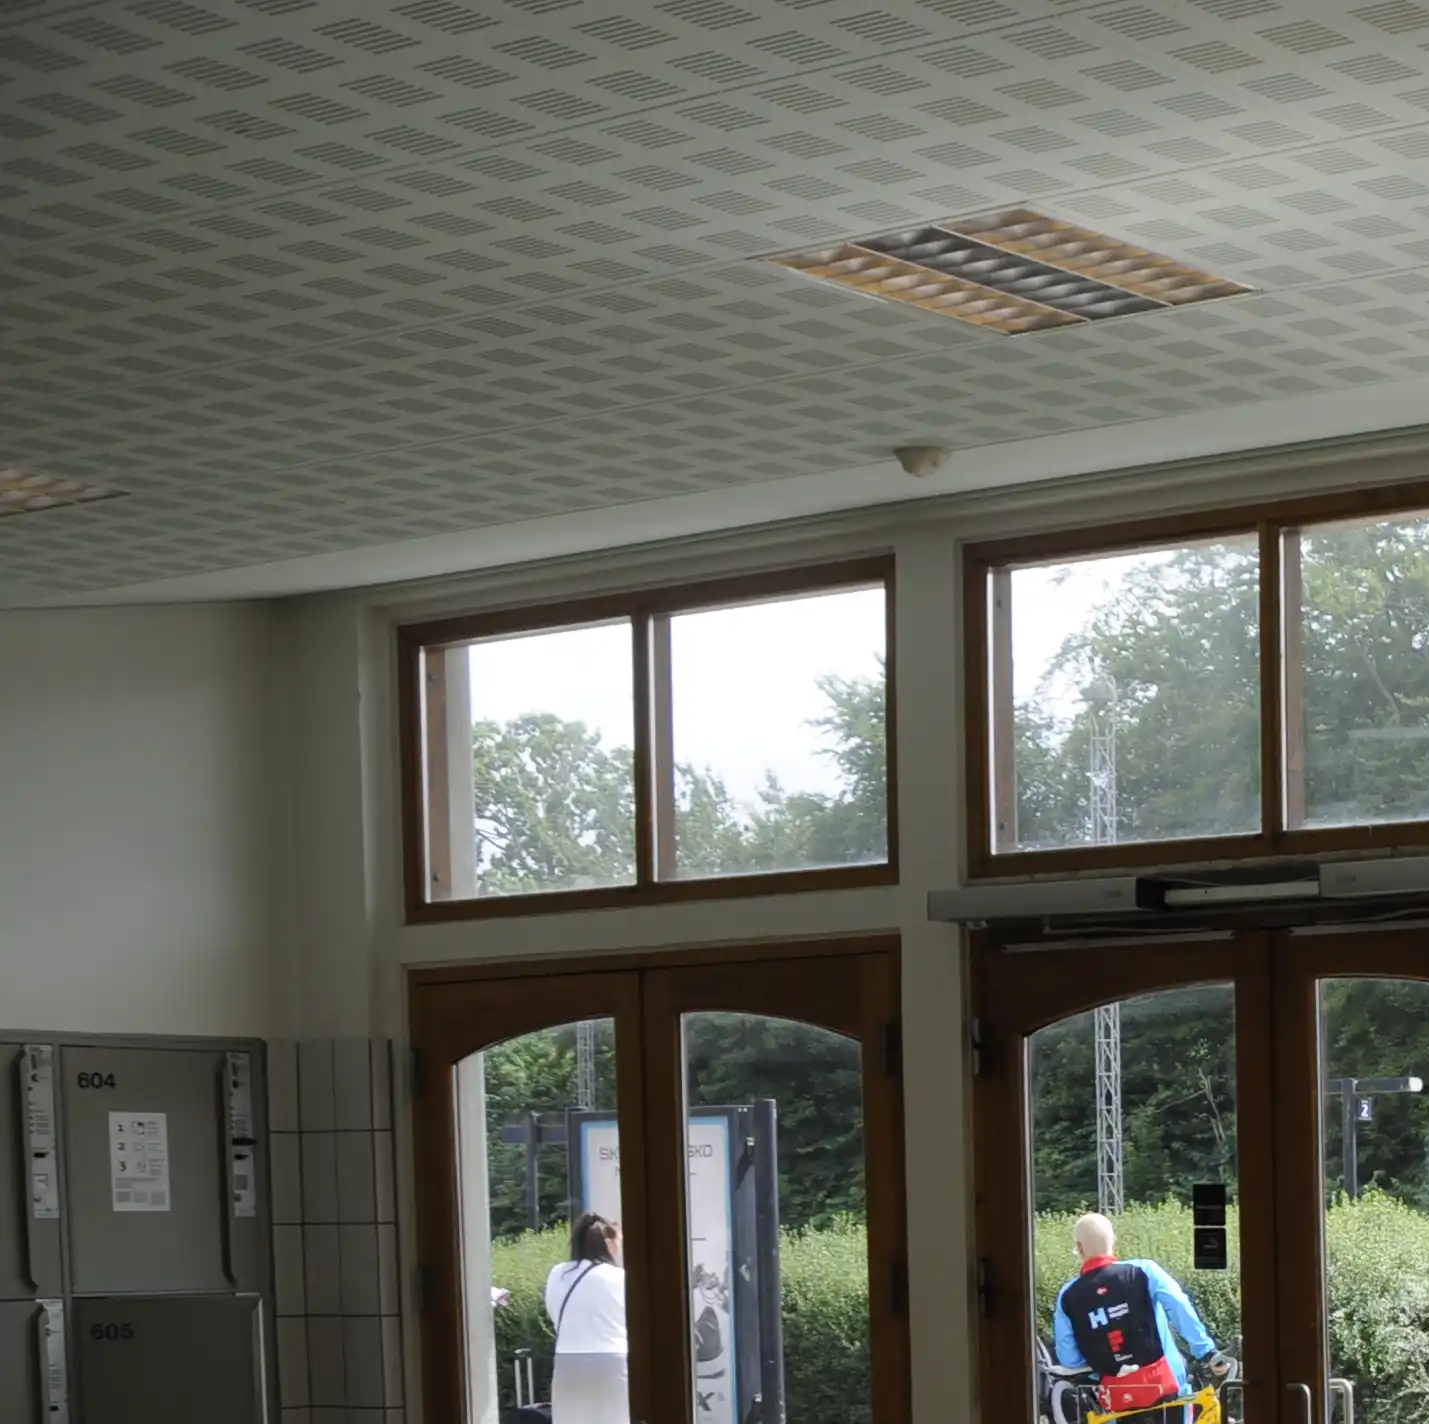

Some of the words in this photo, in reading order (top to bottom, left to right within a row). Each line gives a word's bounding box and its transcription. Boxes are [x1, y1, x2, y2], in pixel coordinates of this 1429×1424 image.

[77, 1071, 117, 1090] 604
[1361, 1104, 1369, 1117] 2
[90, 1323, 134, 1341] 605
